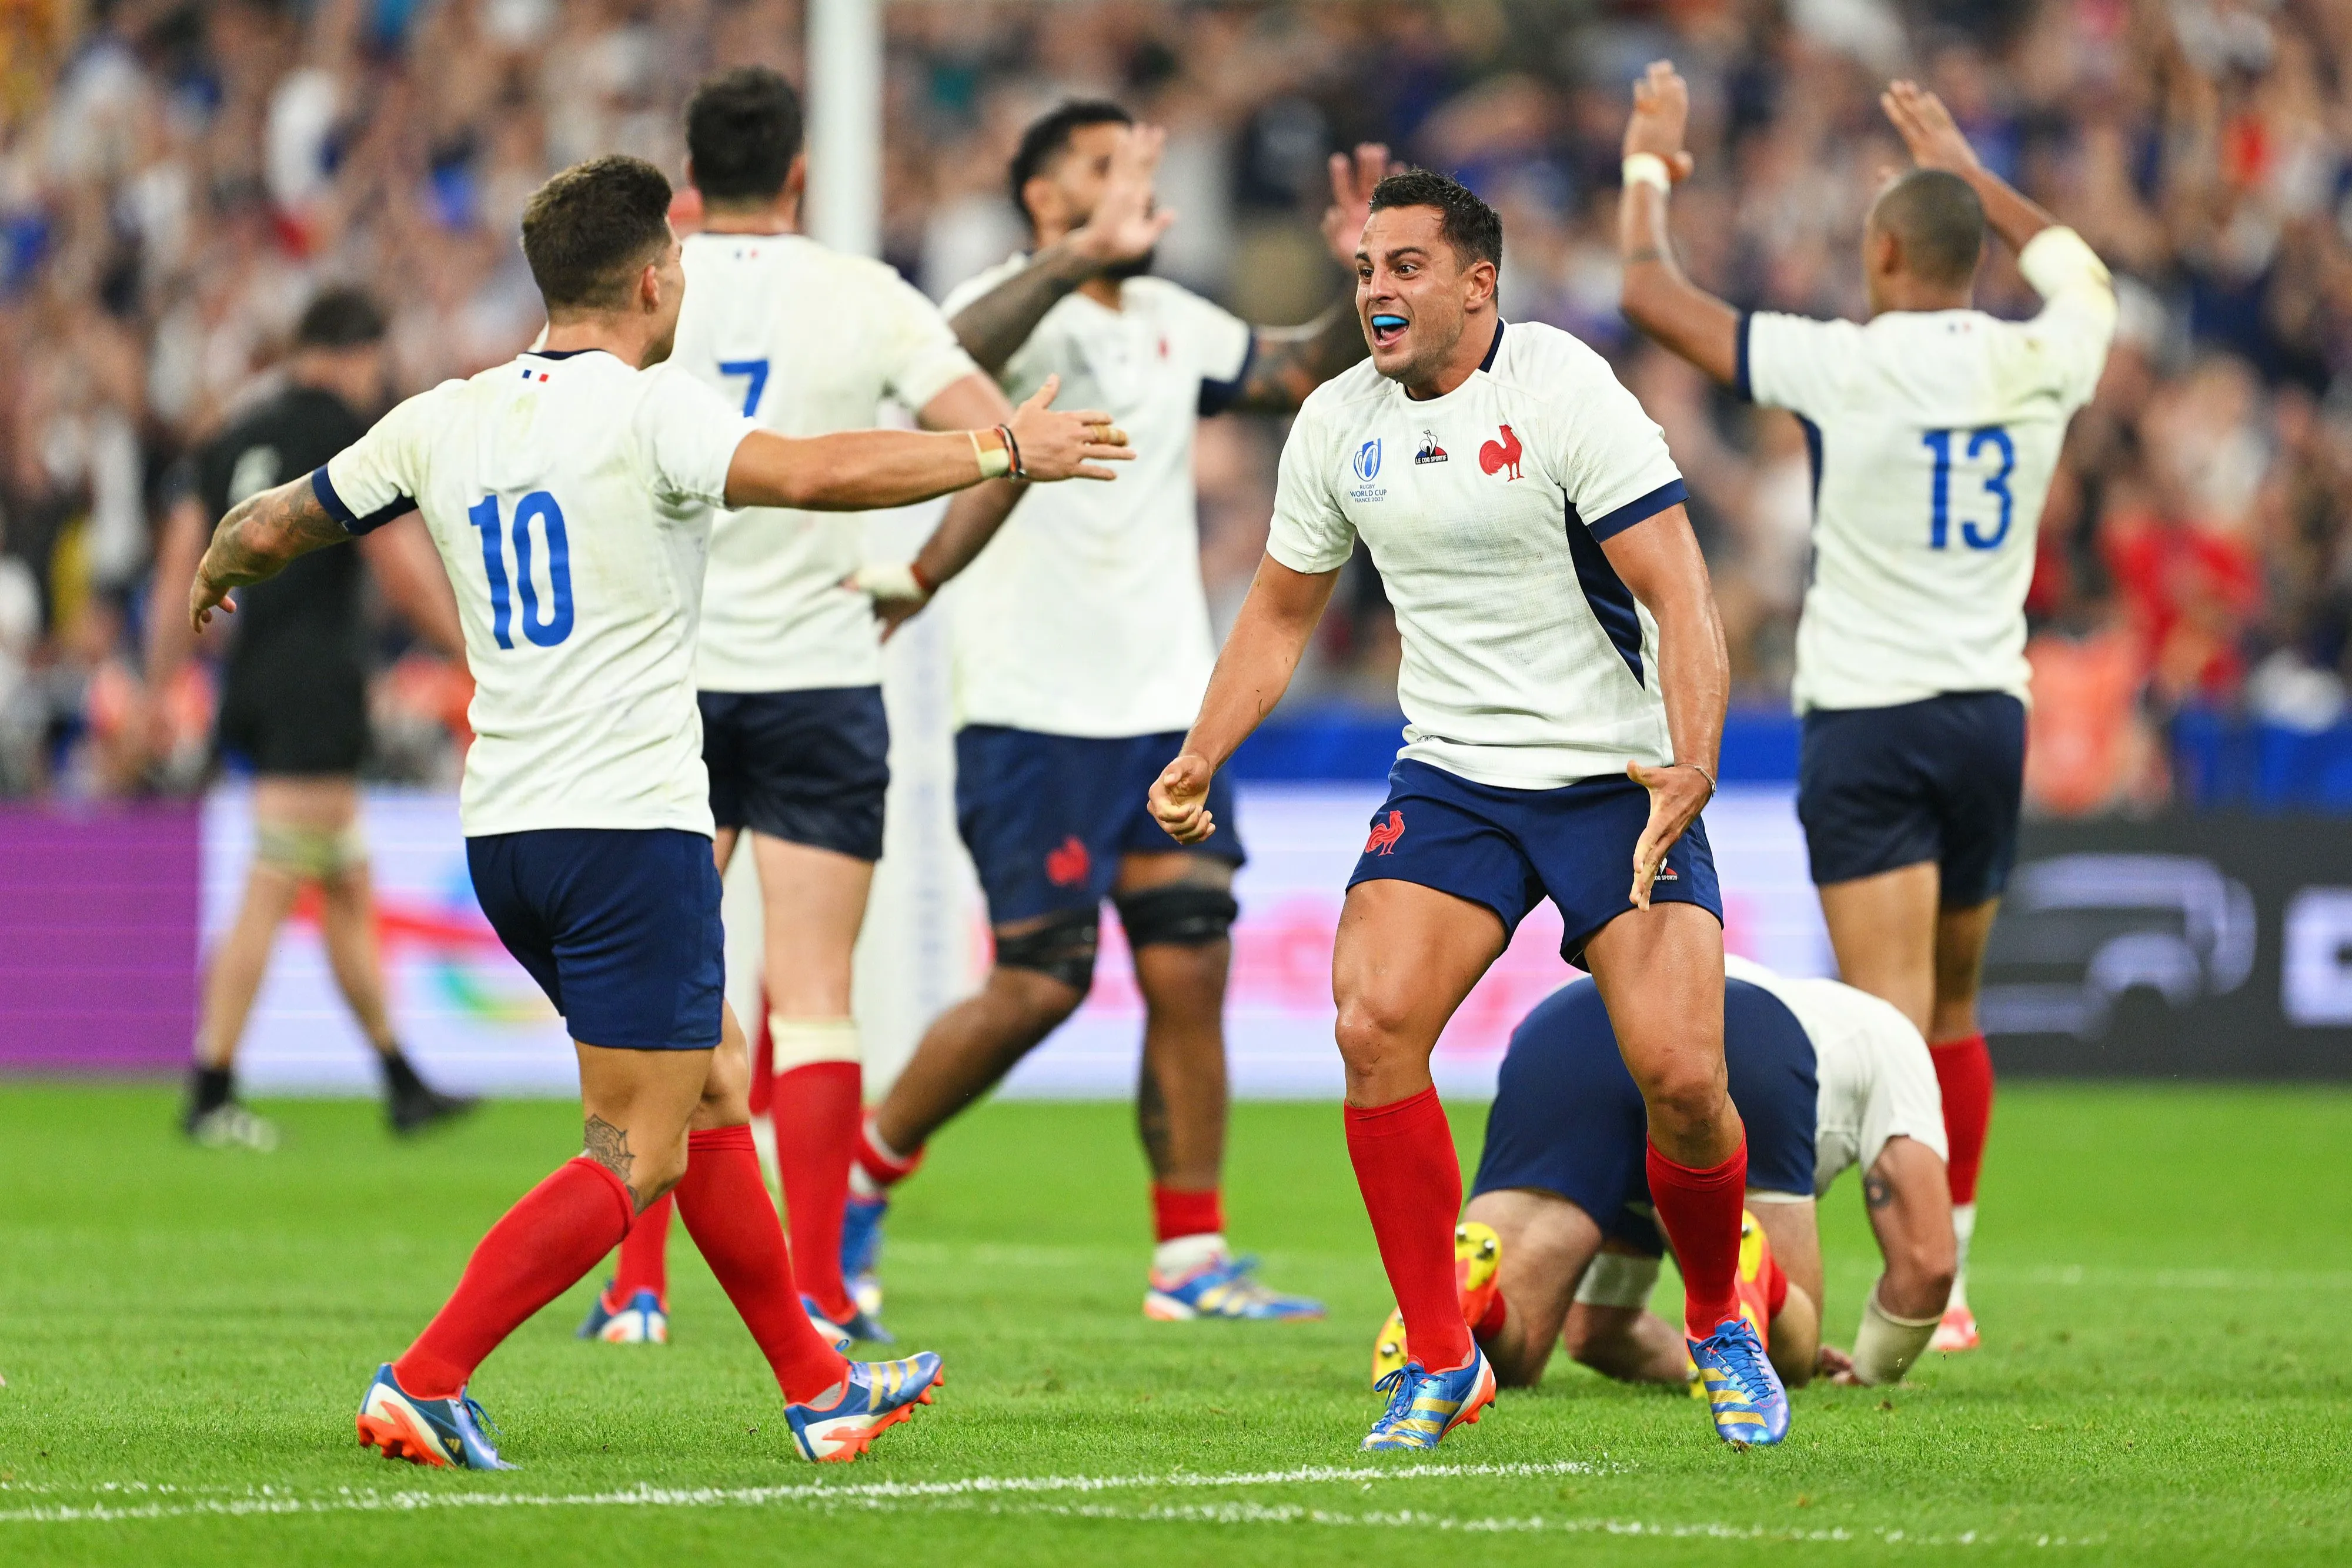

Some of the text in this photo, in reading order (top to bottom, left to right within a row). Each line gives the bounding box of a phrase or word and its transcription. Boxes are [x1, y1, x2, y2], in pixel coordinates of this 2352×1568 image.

[719, 359, 768, 418] 7
[1922, 426, 2014, 550] 13
[468, 491, 574, 649] 10
